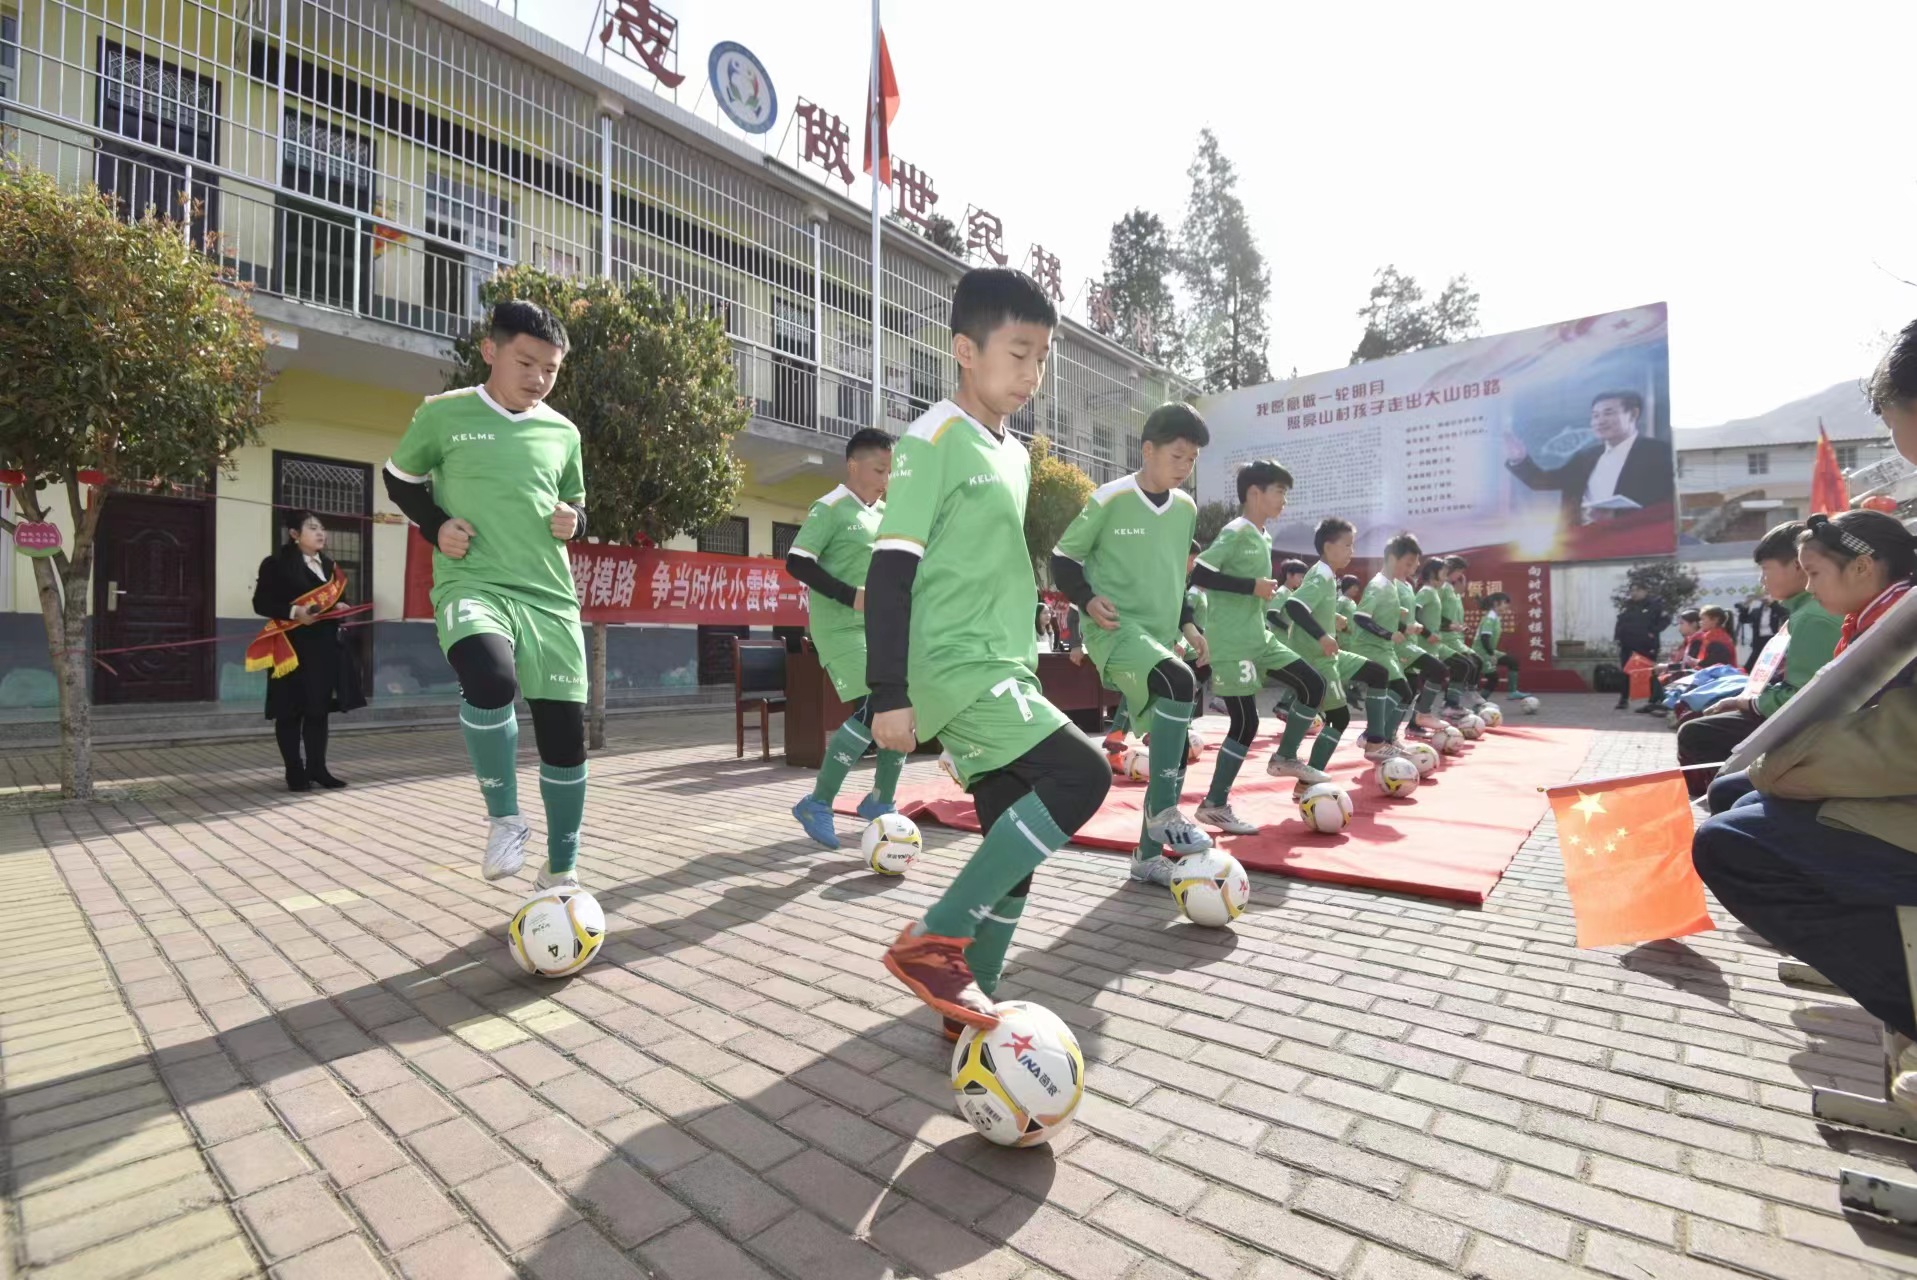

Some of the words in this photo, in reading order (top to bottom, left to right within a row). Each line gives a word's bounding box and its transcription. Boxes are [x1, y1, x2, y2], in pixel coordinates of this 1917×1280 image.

[1287, 379, 1501, 430] 照亮山村孩子走出大山的路
[451, 433, 496, 442] KELME
[443, 598, 485, 632] 15
